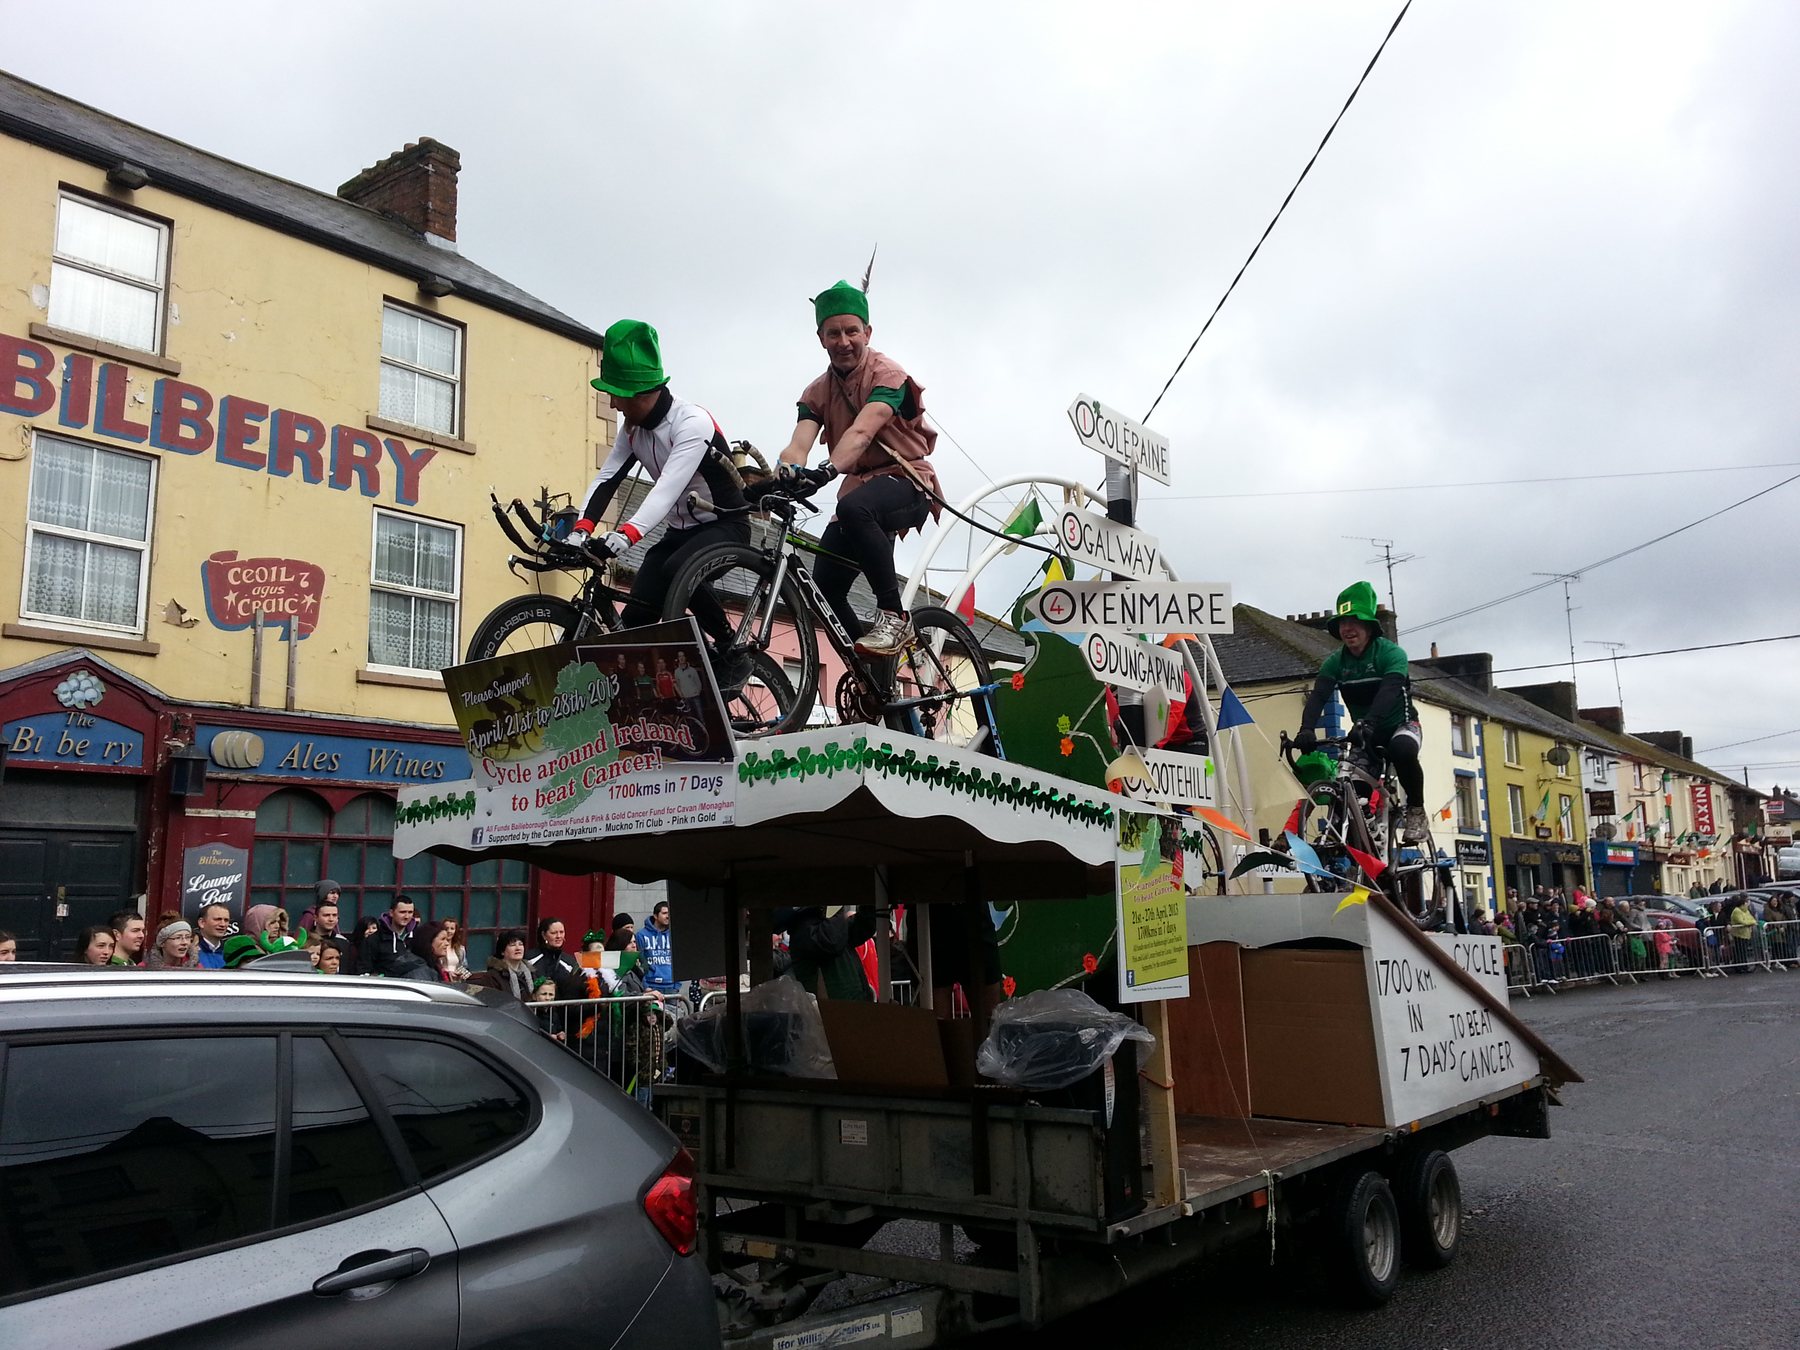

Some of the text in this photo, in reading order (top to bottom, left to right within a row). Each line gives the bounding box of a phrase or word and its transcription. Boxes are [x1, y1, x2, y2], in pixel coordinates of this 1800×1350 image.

[0, 334, 438, 506] BILBERRY
[1096, 414, 1168, 477] COLERAINE
[1066, 517, 1157, 577] 3 GALWAY
[252, 585, 285, 598] agus
[1049, 592, 1227, 626] 4 KENMARE
[483, 640, 496, 660] RO
[493, 609, 534, 641] CARBON
[1095, 641, 1186, 694] 5 DUNGARVAN
[461, 672, 532, 708] Please Support
[66, 711, 96, 727] The
[467, 673, 621, 751] April 21st to 28th 2013
[278, 741, 446, 779] Ales Wines
[482, 717, 697, 786] Cycle around Ireland
[511, 747, 664, 812] to beat Cancer!
[608, 775, 724, 800] 1700kms in 7 Days
[488, 831, 521, 844] Supported
[521, 830, 531, 841] by
[531, 830, 542, 839] the
[543, 828, 564, 839] Cavan
[564, 825, 598, 838] Kayakrun
[605, 821, 633, 833] Muckno
[635, 819, 645, 830] Tri
[646, 818, 663, 828] Club
[671, 814, 688, 826] Pink
[697, 812, 717, 824] Gold
[494, 824, 511, 832] Funds
[549, 818, 569, 828] Cancer
[569, 816, 585, 825] Fund
[591, 815, 604, 823] Pink
[611, 812, 626, 821] Gold
[627, 809, 649, 819] Cancer
[649, 808, 666, 817] Fund
[666, 806, 676, 815] for
[676, 805, 698, 814] Cavan
[1695, 786, 1711, 834] NIXYS
[199, 856, 236, 867] Bilberry
[186, 873, 243, 894] Lounge
[199, 888, 233, 909] Bar
[1375, 958, 1413, 996] 1700
[1454, 943, 1500, 976] CYCLE
[1449, 1008, 1493, 1041] TO BEAT
[1401, 1040, 1457, 1081] 7 DAYS
[1460, 1040, 1515, 1082] CANCER
